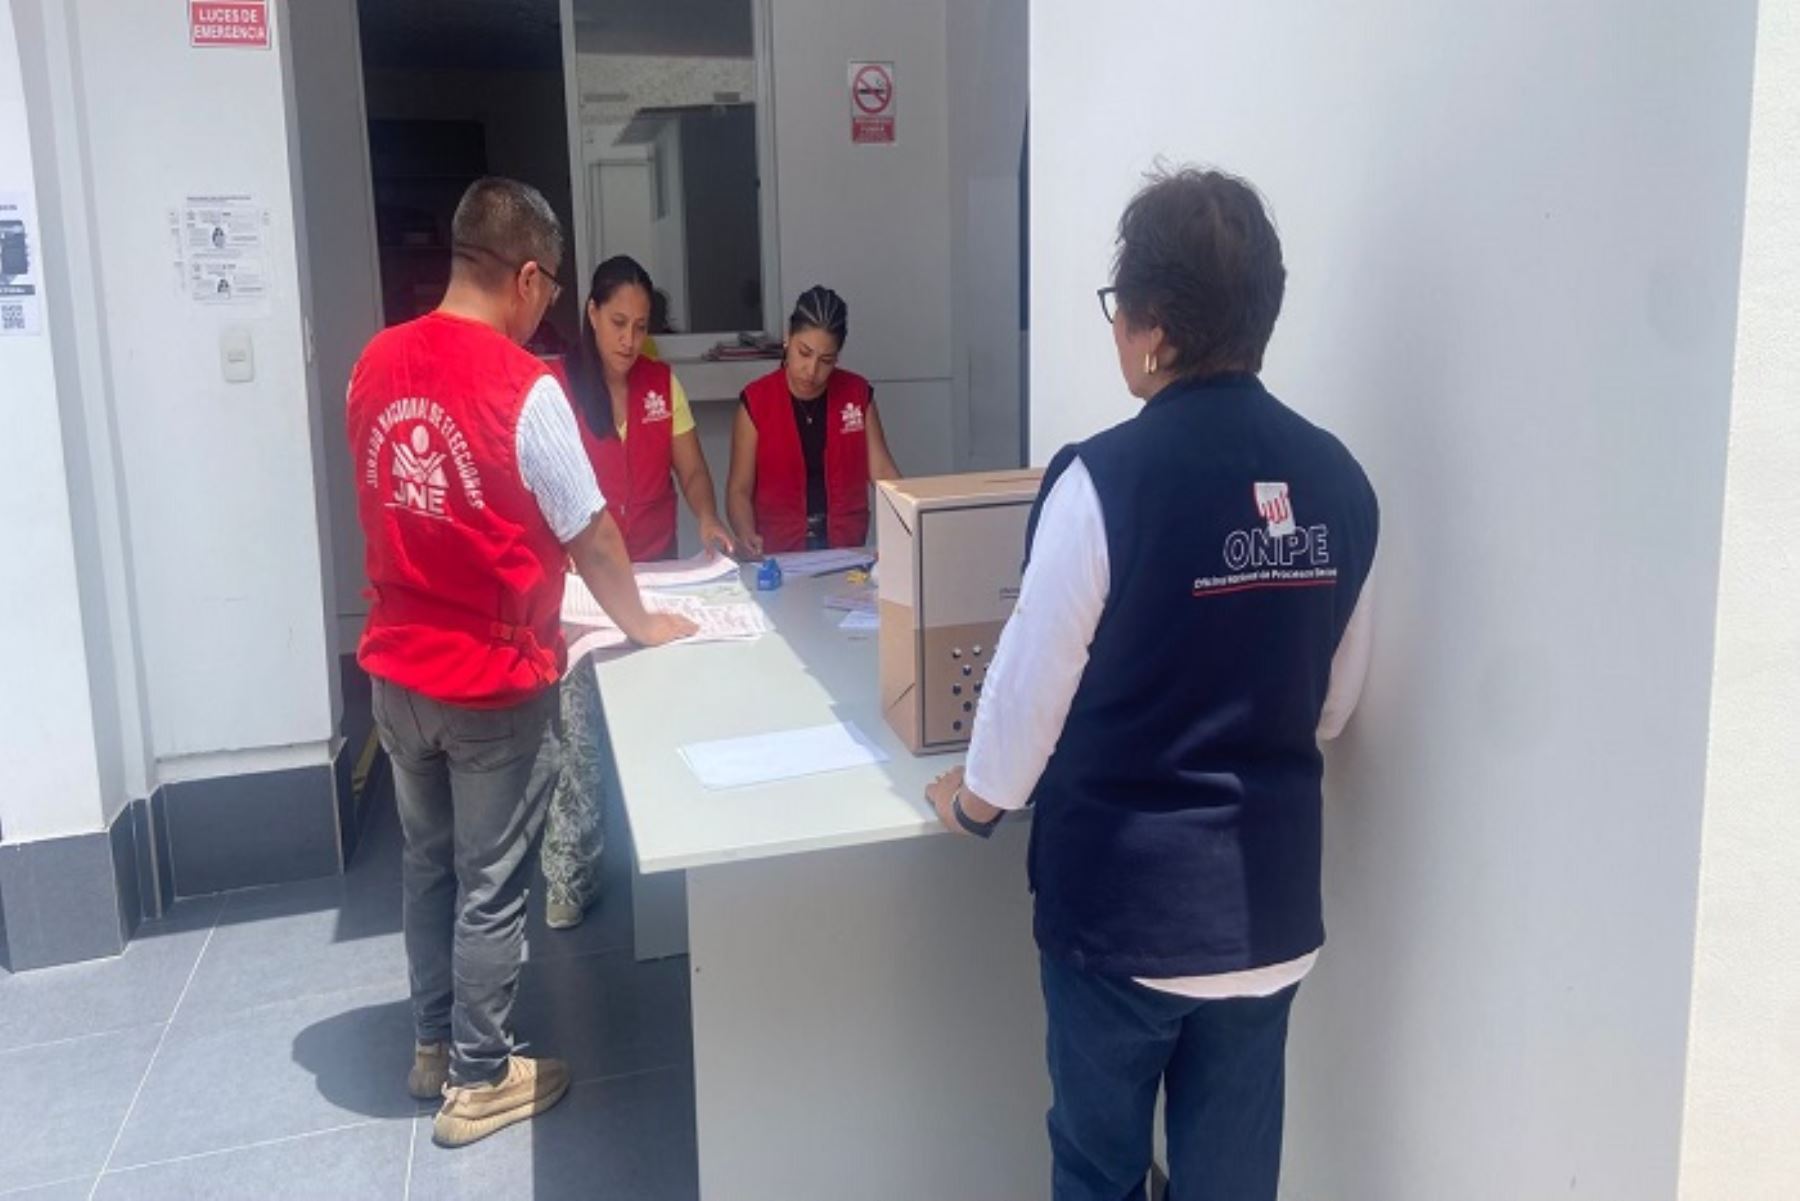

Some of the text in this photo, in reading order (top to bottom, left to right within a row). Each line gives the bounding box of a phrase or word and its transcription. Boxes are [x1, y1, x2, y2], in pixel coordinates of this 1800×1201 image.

[194, 24, 265, 40] EMERGENCIA
[199, 8, 258, 23] LUCES DE
[440, 415, 486, 510] ELECCIONES
[392, 479, 446, 515] JNE
[1223, 524, 1330, 571] ONPE
